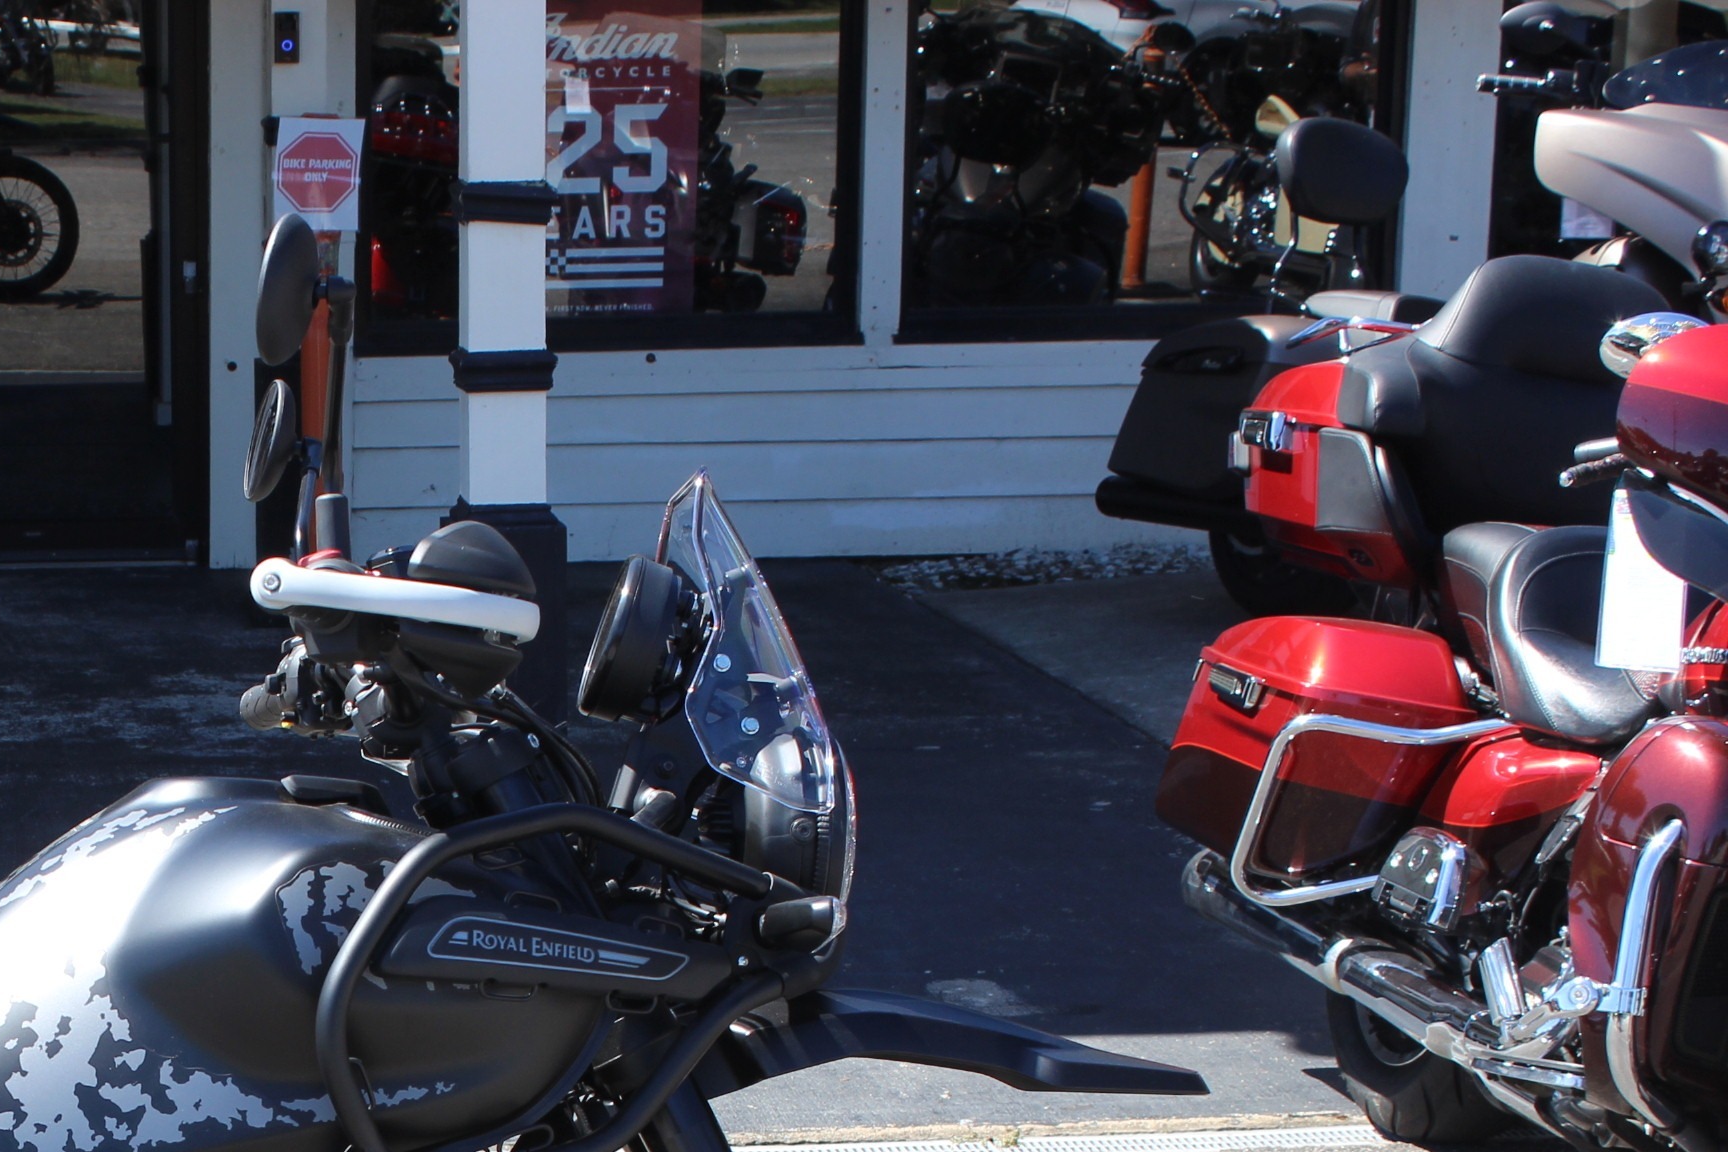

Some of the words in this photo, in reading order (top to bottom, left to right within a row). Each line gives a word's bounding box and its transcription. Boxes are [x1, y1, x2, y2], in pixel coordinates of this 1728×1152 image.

[546, 66, 671, 79] TORCYCLE
[283, 159, 306, 169] BIKE
[308, 159, 352, 169] PARKING
[304, 172, 329, 182] ONLY
[546, 204, 667, 239] EARS
[472, 929, 528, 952] ROYAL
[532, 936, 595, 963] ENFIELD
